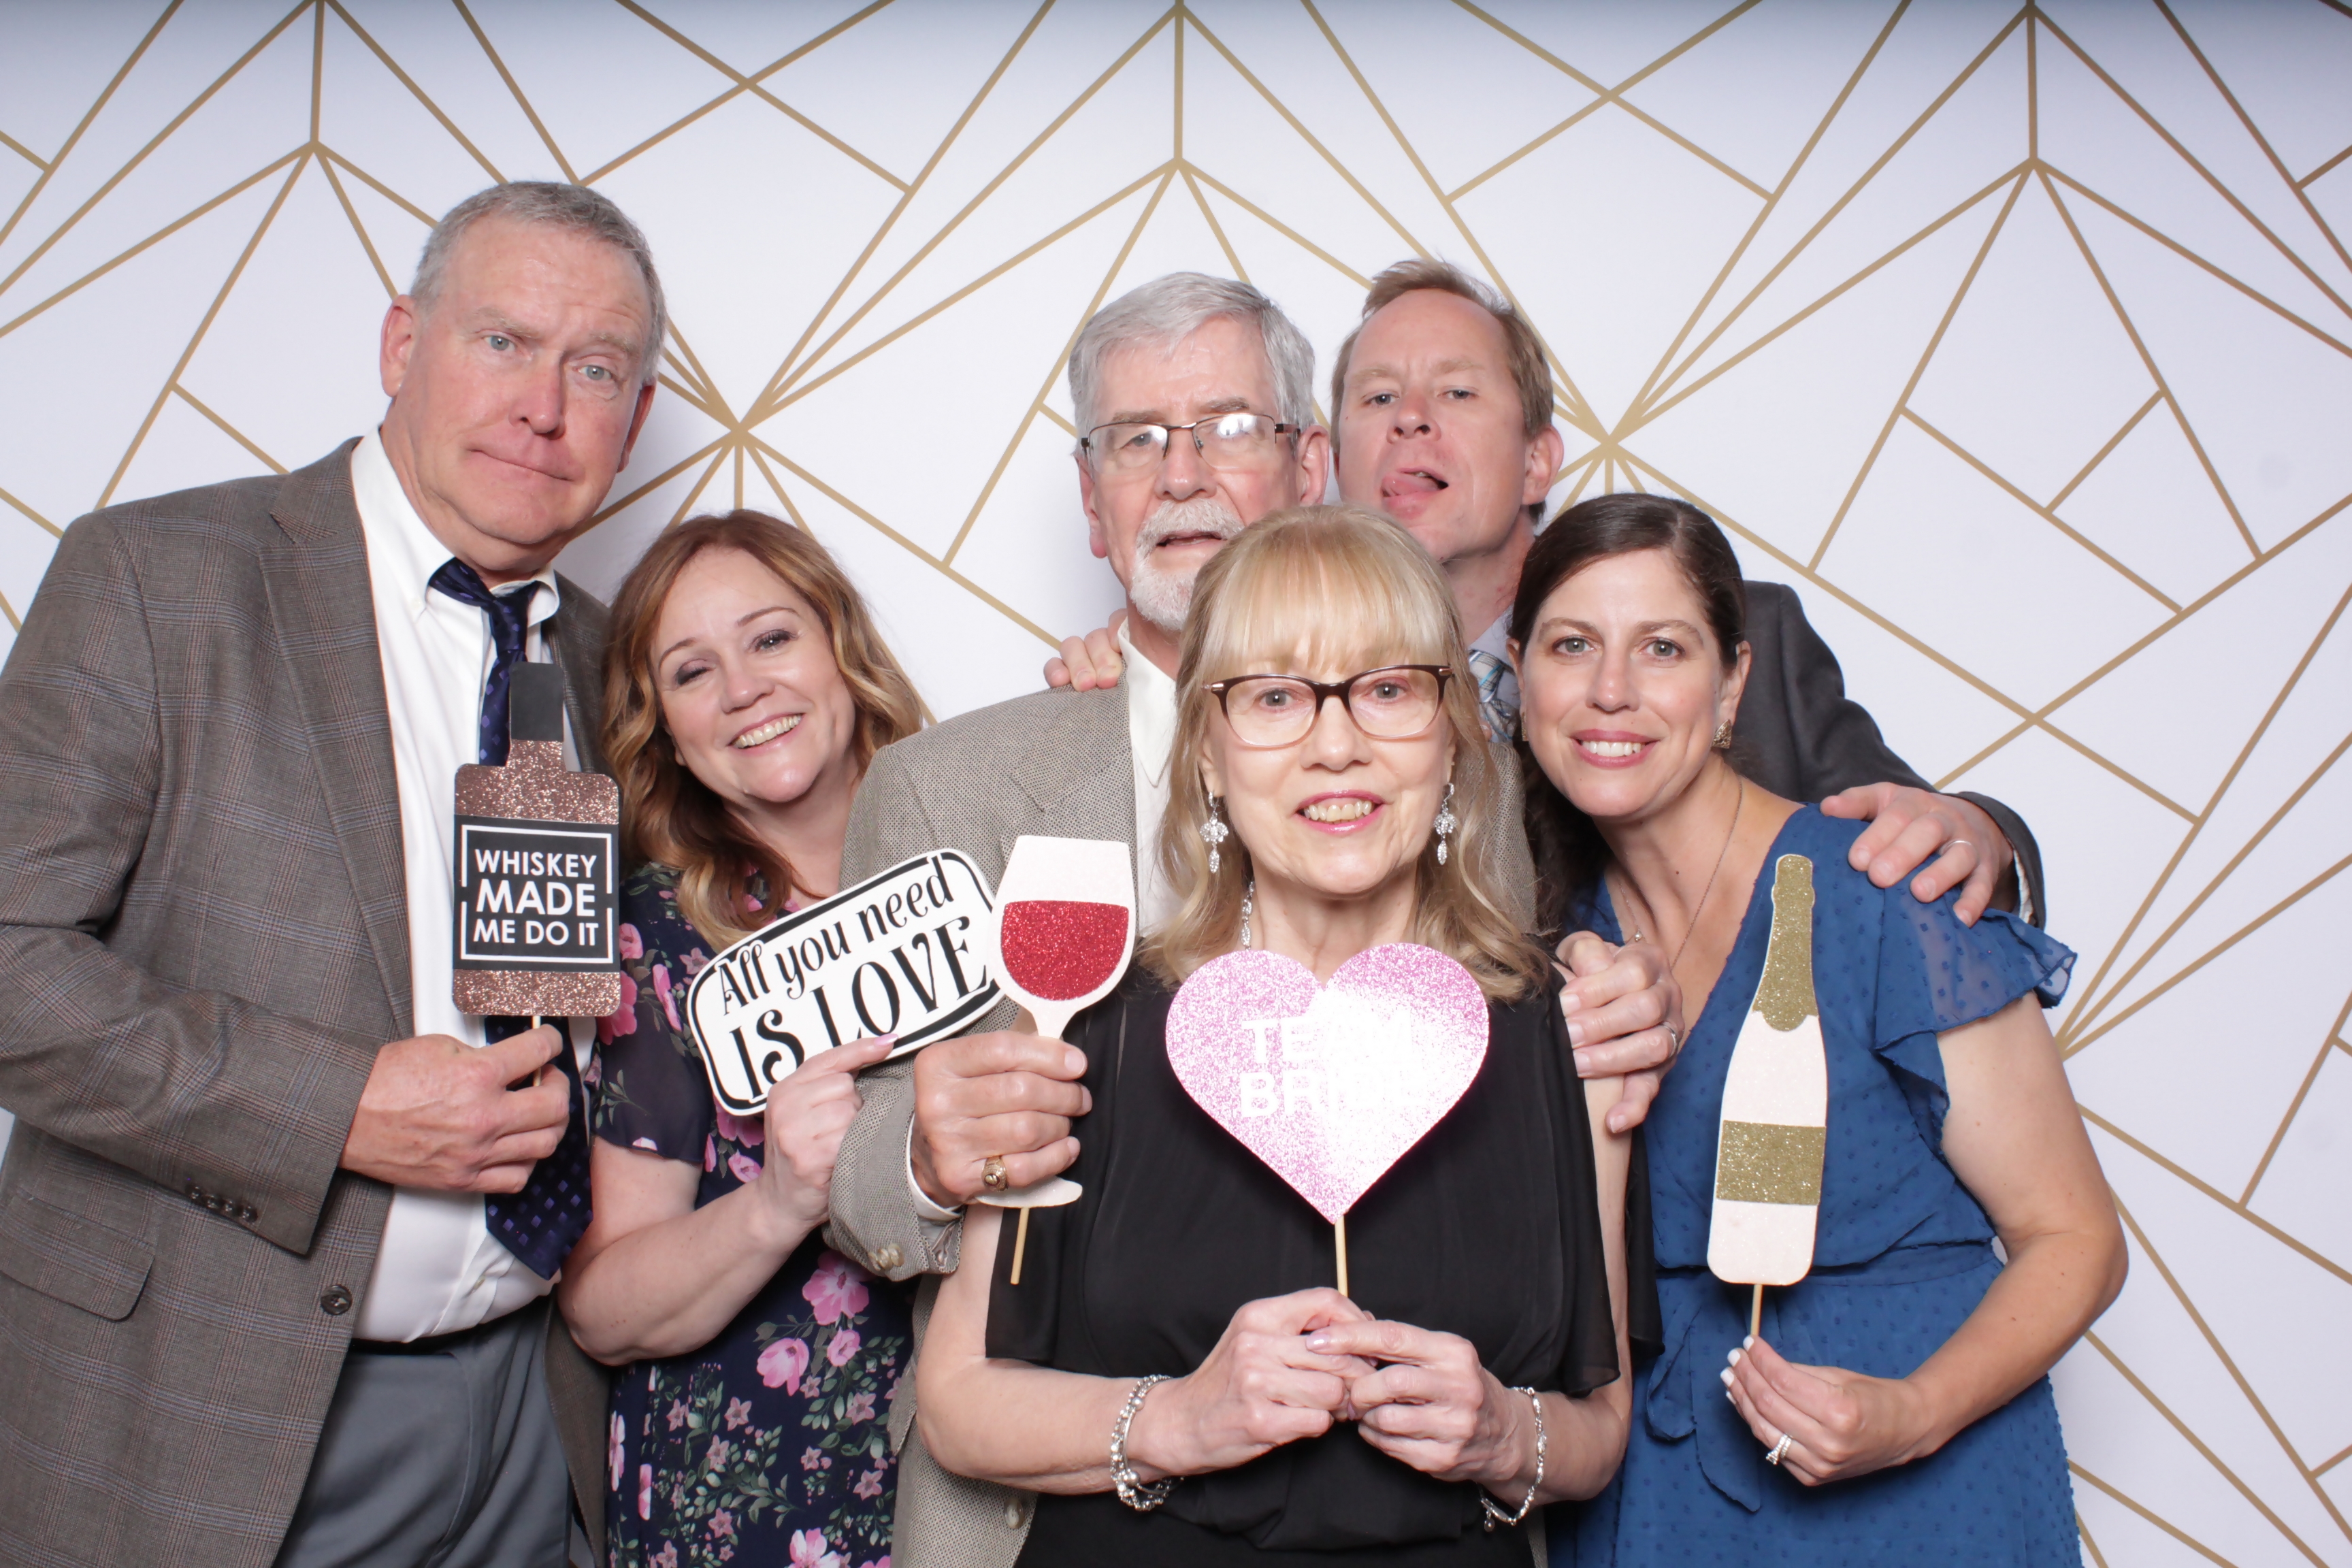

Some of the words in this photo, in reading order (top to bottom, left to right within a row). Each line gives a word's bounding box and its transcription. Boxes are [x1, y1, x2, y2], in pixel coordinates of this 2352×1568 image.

[474, 849, 597, 878] WHISKEY
[476, 879, 595, 917] MADE
[473, 918, 516, 944] ME
[525, 920, 570, 945] DO
[578, 922, 599, 946] IT
[716, 943, 770, 1016] All
[774, 921, 852, 1000] you
[855, 855, 955, 943] need
[728, 1009, 805, 1100] IS
[809, 915, 987, 1048] LOVE
[1241, 1010, 1412, 1064] TE
[1239, 1063, 1426, 1117] BRI
